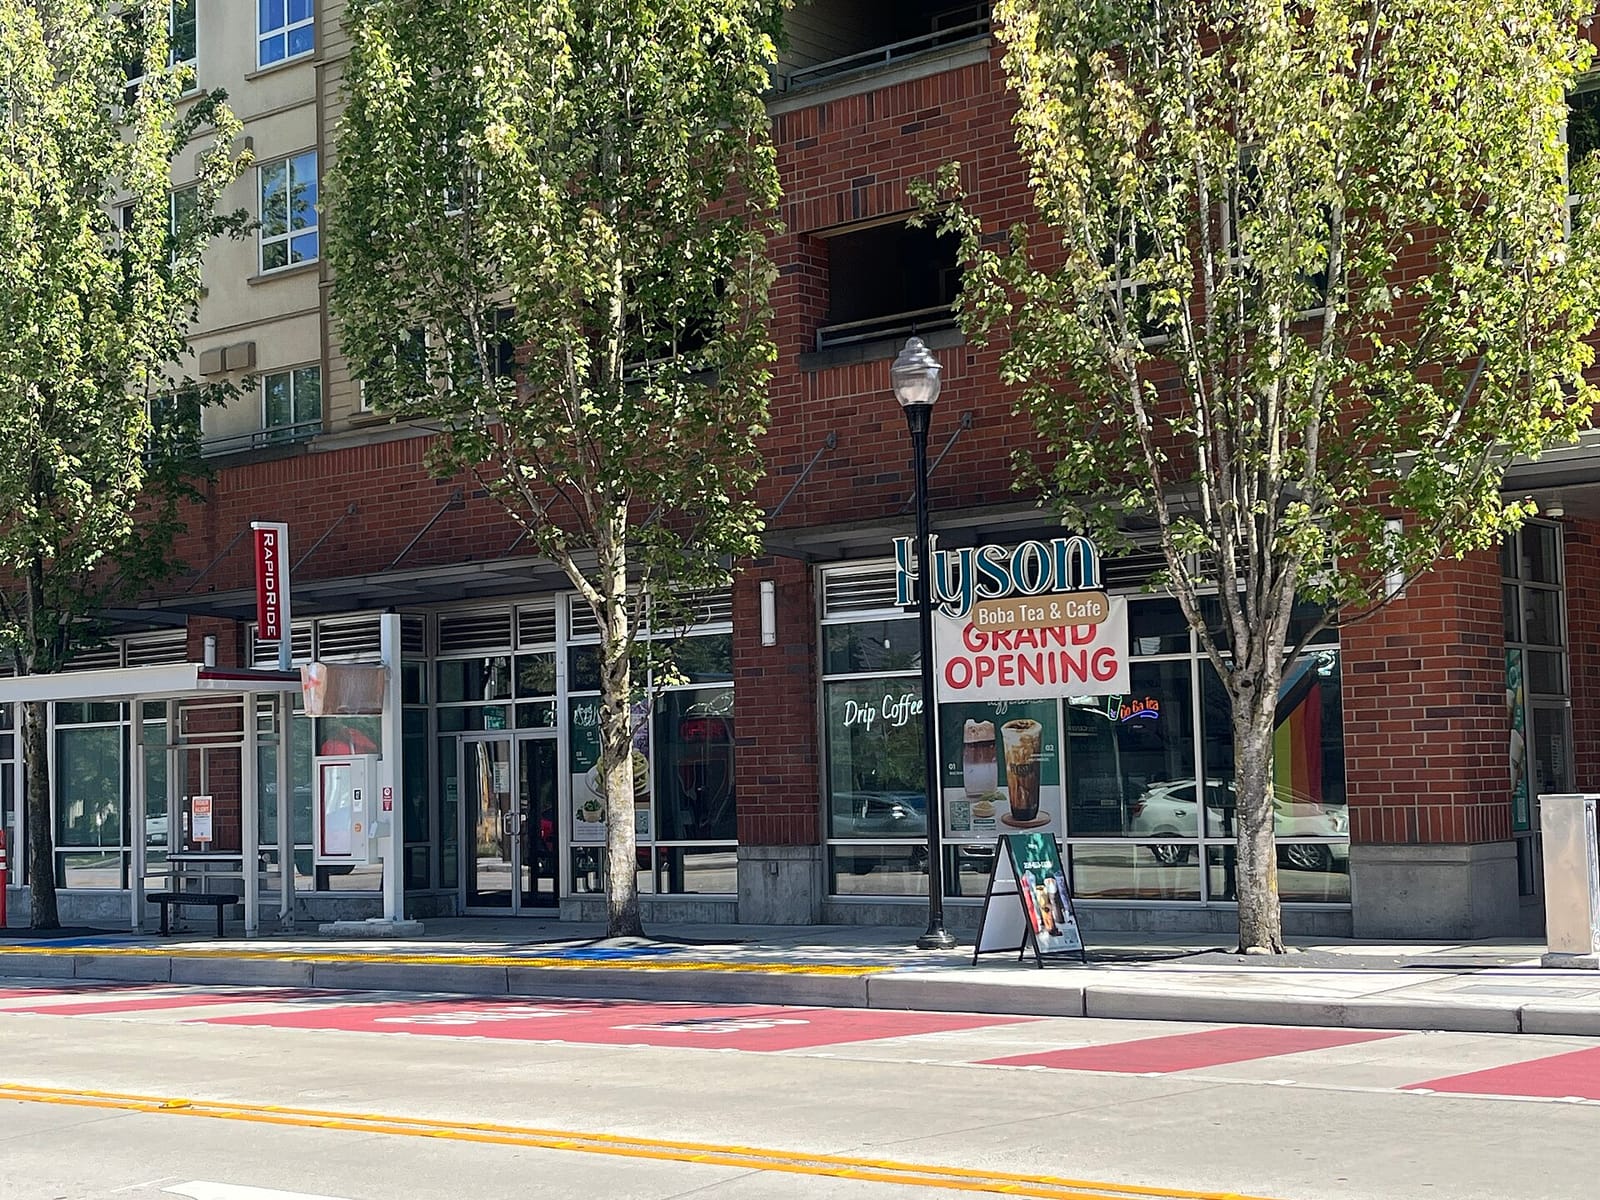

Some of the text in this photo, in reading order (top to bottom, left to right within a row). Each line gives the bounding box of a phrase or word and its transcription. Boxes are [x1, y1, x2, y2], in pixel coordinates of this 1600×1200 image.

[263, 533, 277, 637] RAPIDRIDE
[891, 534, 1104, 620] Hyson
[978, 600, 1101, 626] Boba Tea & Cafe
[962, 621, 1098, 653] GRAND
[944, 647, 1119, 690] OPENING
[843, 693, 924, 732] Drip Coffee
